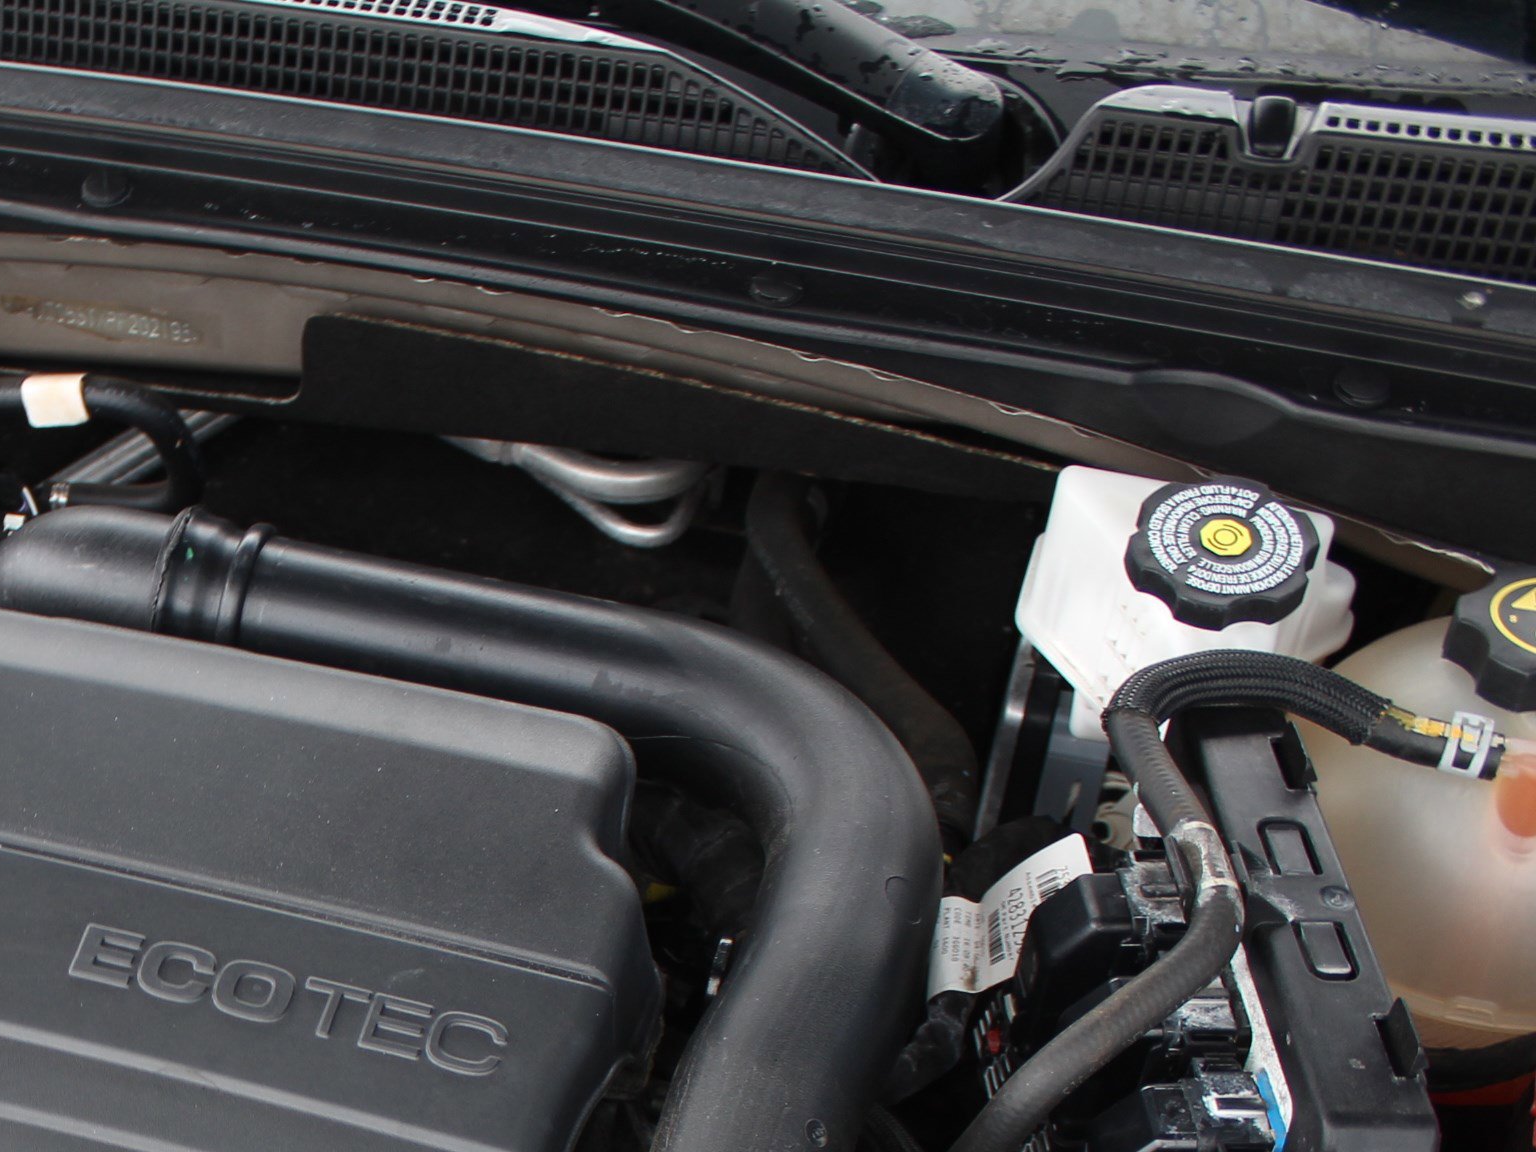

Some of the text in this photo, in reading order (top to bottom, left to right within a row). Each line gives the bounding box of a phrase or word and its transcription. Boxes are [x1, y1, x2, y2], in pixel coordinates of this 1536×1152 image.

[1170, 486, 1202, 505] FROM
[1198, 484, 1230, 496] FLUID
[1190, 494, 1232, 508] BEFORE
[1148, 502, 1174, 531] SEALED
[1177, 510, 1203, 534] CLEAN
[1165, 544, 1190, 566] ONLY
[1177, 533, 1200, 559] FILLER
[1191, 565, 1213, 580] DOT
[1209, 571, 1238, 583] FREIN
[1236, 571, 1251, 583] DE
[1247, 569, 1289, 592] BOUCHON
[1220, 582, 1252, 593] AVANT
[67, 921, 510, 1077] ECOTEC
